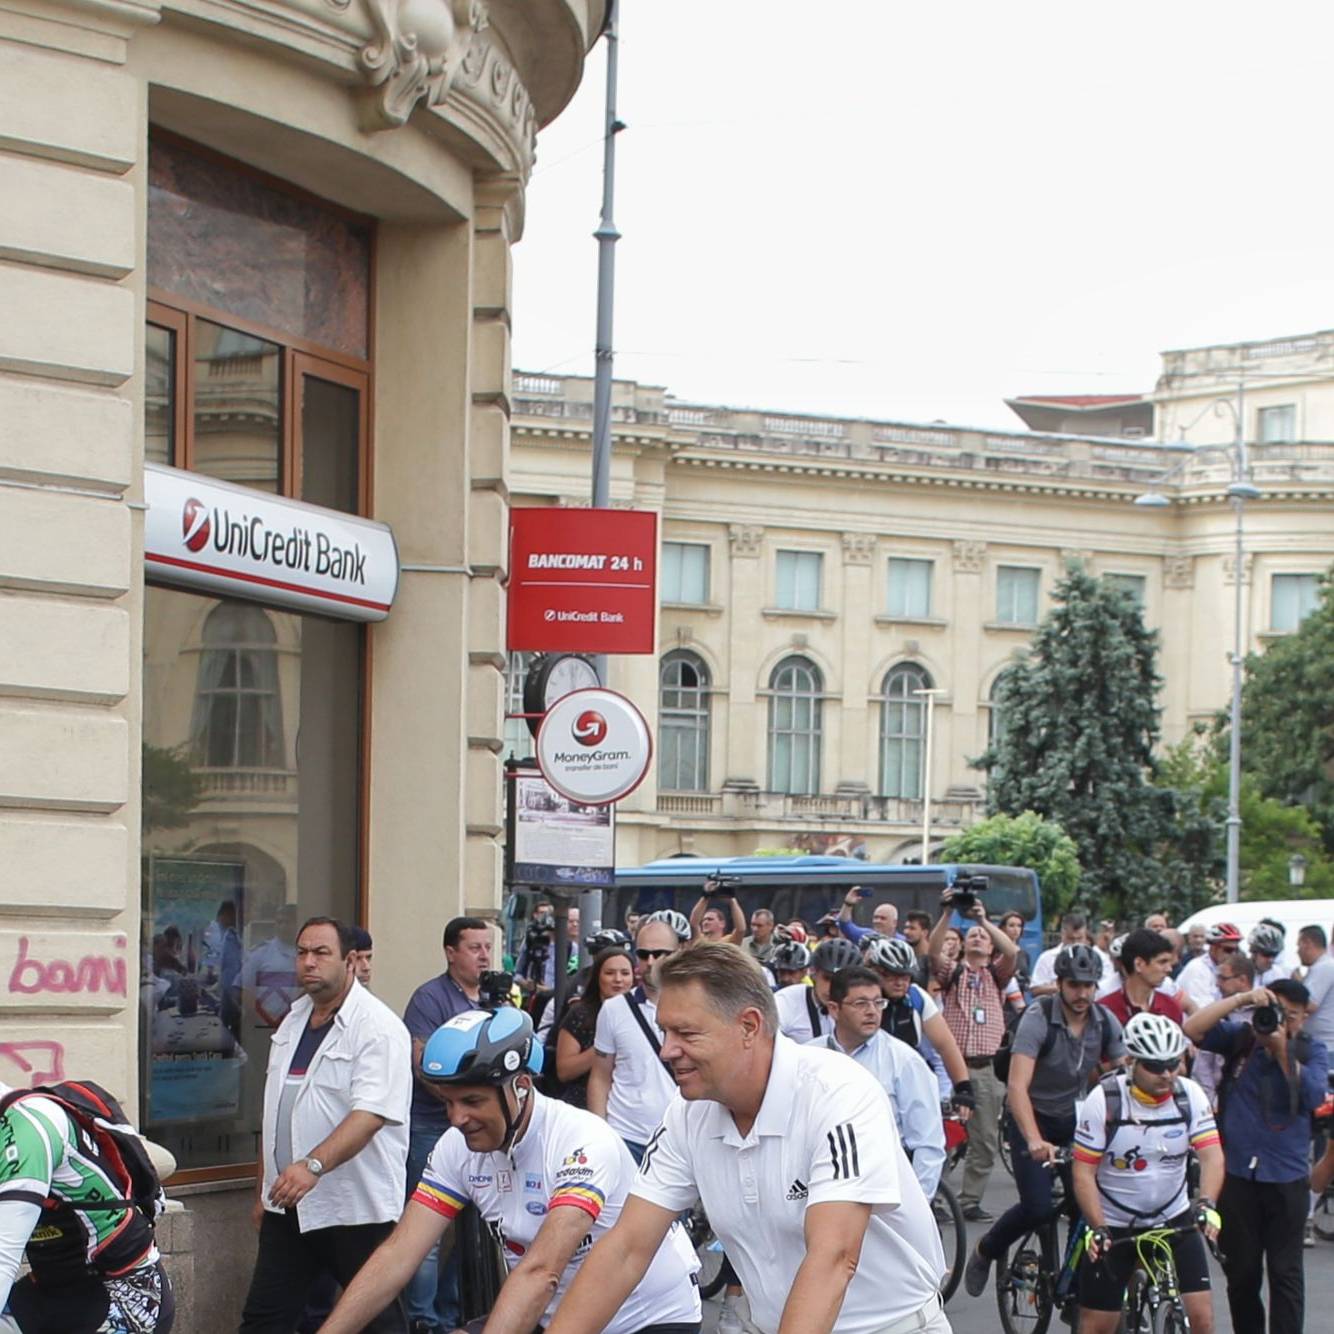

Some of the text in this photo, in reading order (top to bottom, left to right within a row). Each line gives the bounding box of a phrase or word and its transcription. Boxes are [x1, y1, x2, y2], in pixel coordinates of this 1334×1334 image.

[213, 507, 366, 585] UniCredit Bank
[528, 554, 643, 571] BANCOMAT 24 h
[557, 611, 624, 622] UniCredit Bank
